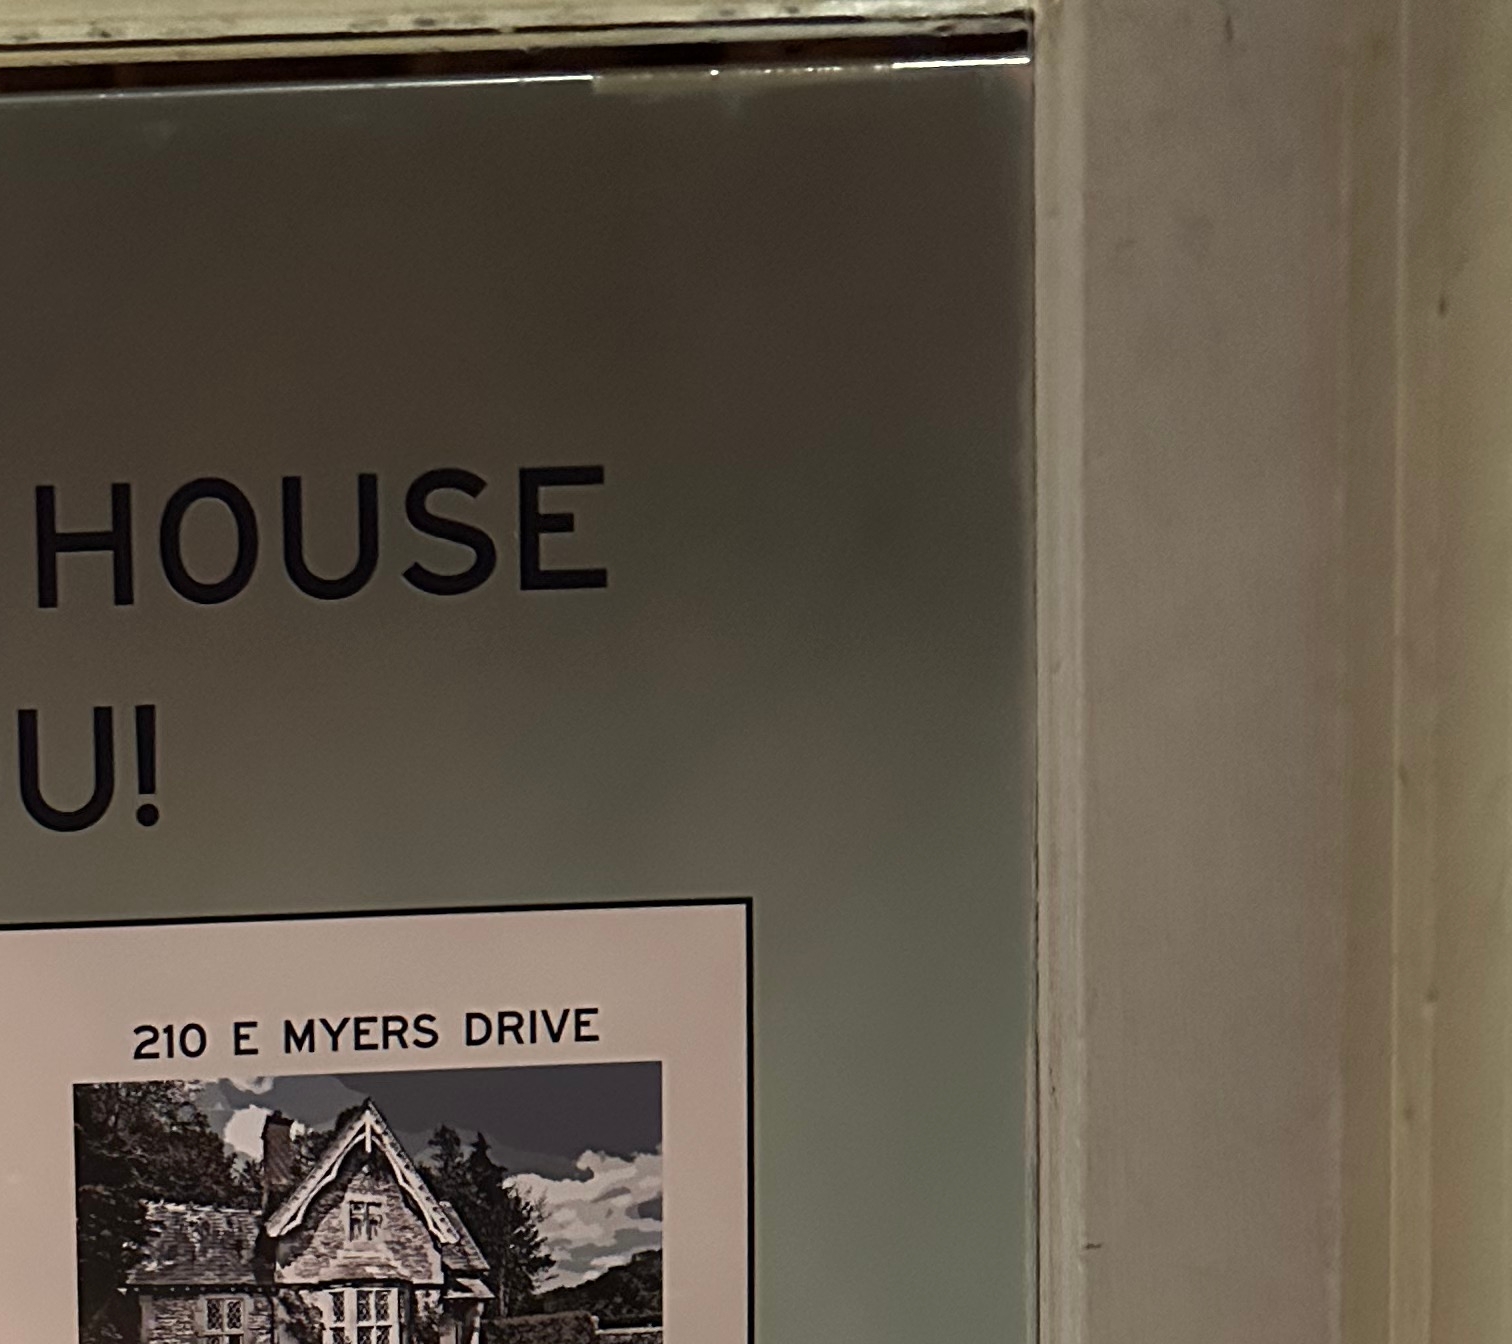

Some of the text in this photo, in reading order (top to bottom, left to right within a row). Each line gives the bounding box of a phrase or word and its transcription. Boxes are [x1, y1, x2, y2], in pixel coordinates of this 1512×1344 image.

[34, 464, 608, 609] HOUSE
[133, 1007, 600, 1060] 210 E MYERS DRIVE
